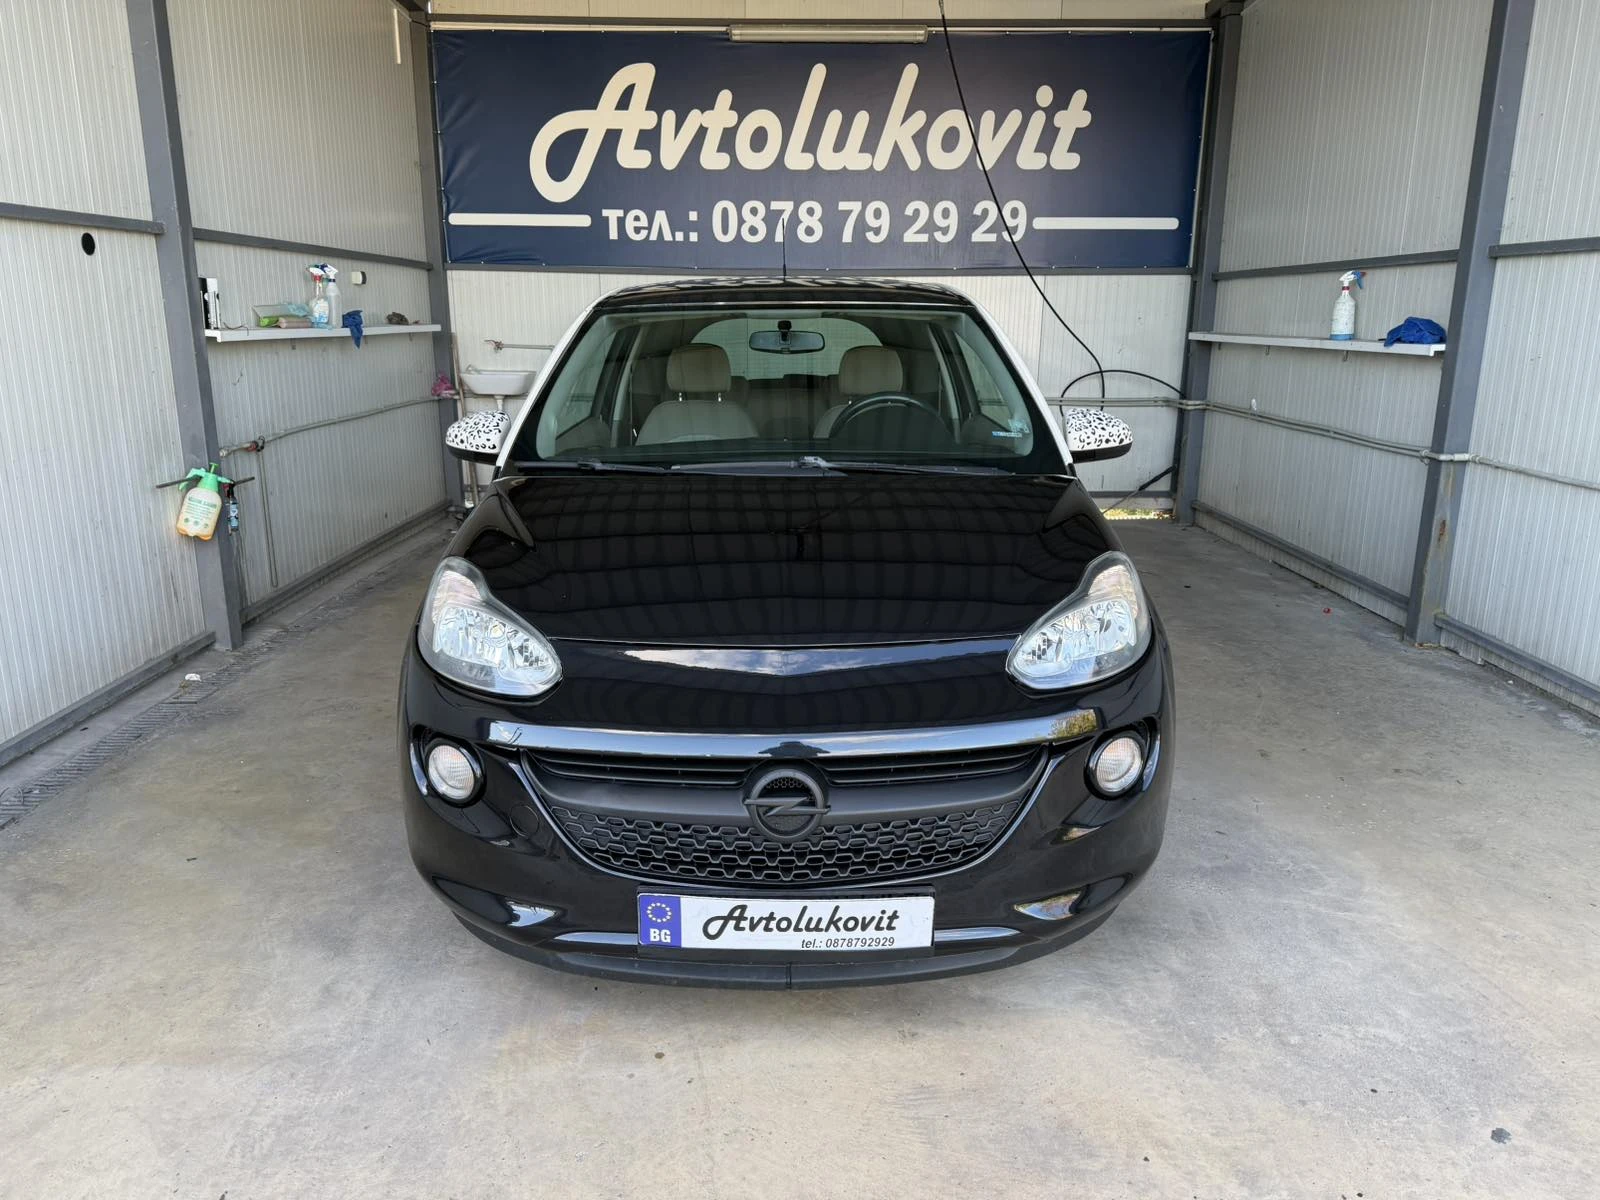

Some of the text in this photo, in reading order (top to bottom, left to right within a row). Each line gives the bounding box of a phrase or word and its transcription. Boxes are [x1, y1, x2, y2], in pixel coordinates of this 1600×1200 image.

[529, 62, 1092, 203] Avtolukovit
[602, 200, 1027, 243] тел.: 0878 79 29 29
[650, 928, 671, 943] BG
[702, 904, 900, 940] Avtolukovit
[801, 937, 895, 949] tel.: 0878792929
